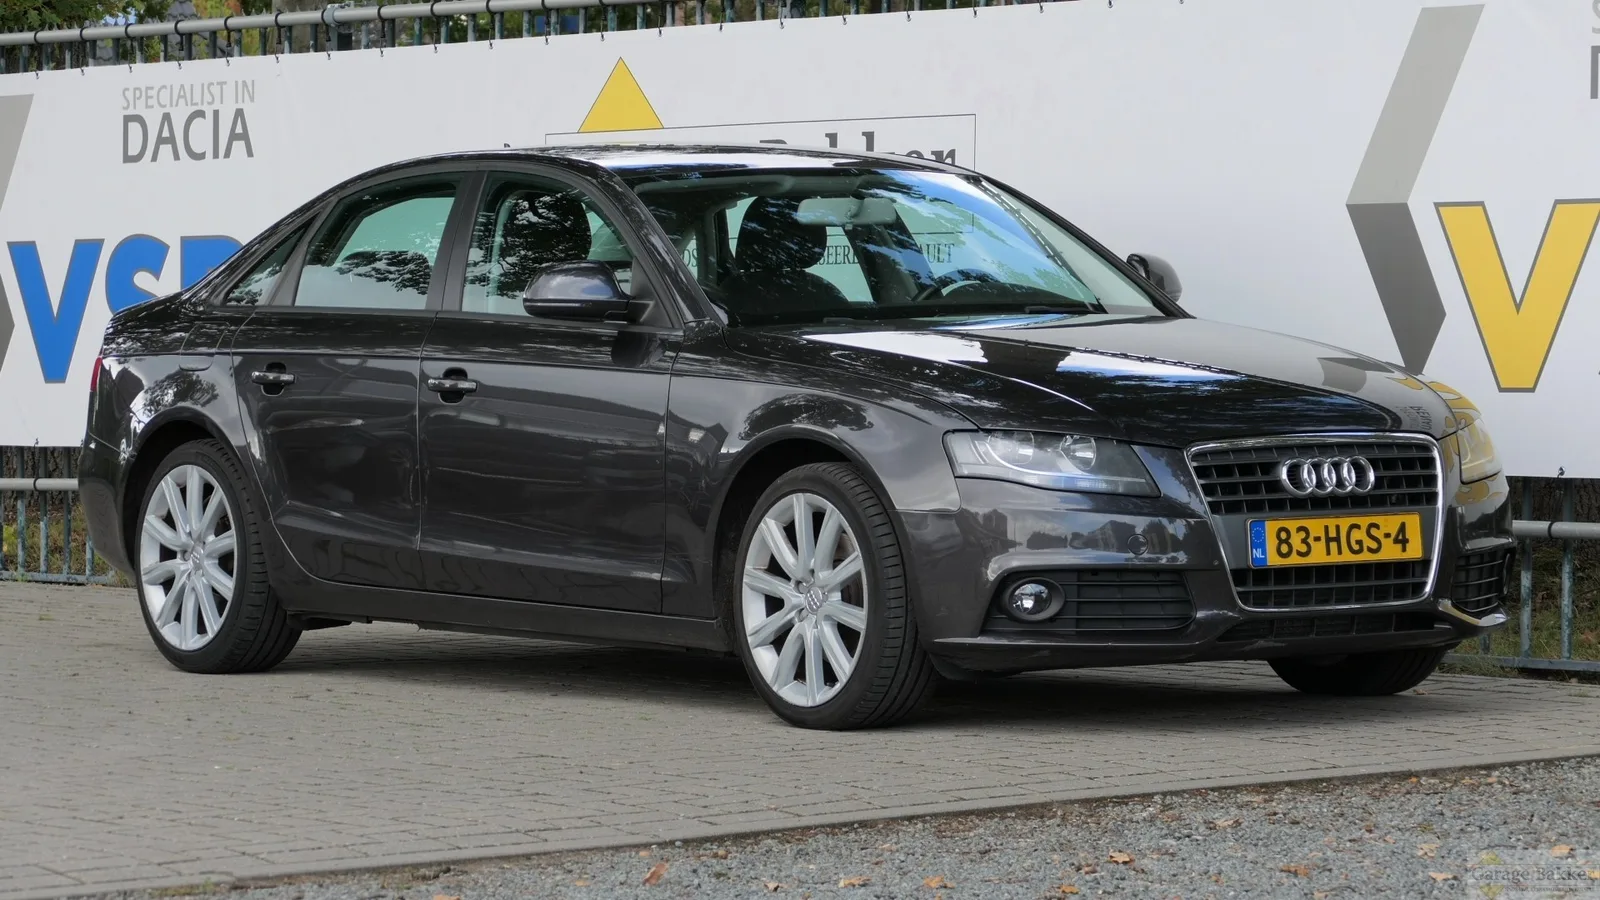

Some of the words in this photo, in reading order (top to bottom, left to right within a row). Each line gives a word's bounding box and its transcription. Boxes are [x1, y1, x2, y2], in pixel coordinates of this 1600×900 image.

[122, 81, 227, 111] SPECIALIST
[235, 80, 255, 104] IN
[122, 108, 254, 164] DACIA
[1252, 548, 1265, 558] NL
[1275, 521, 1410, 559] 83-HGS-4
